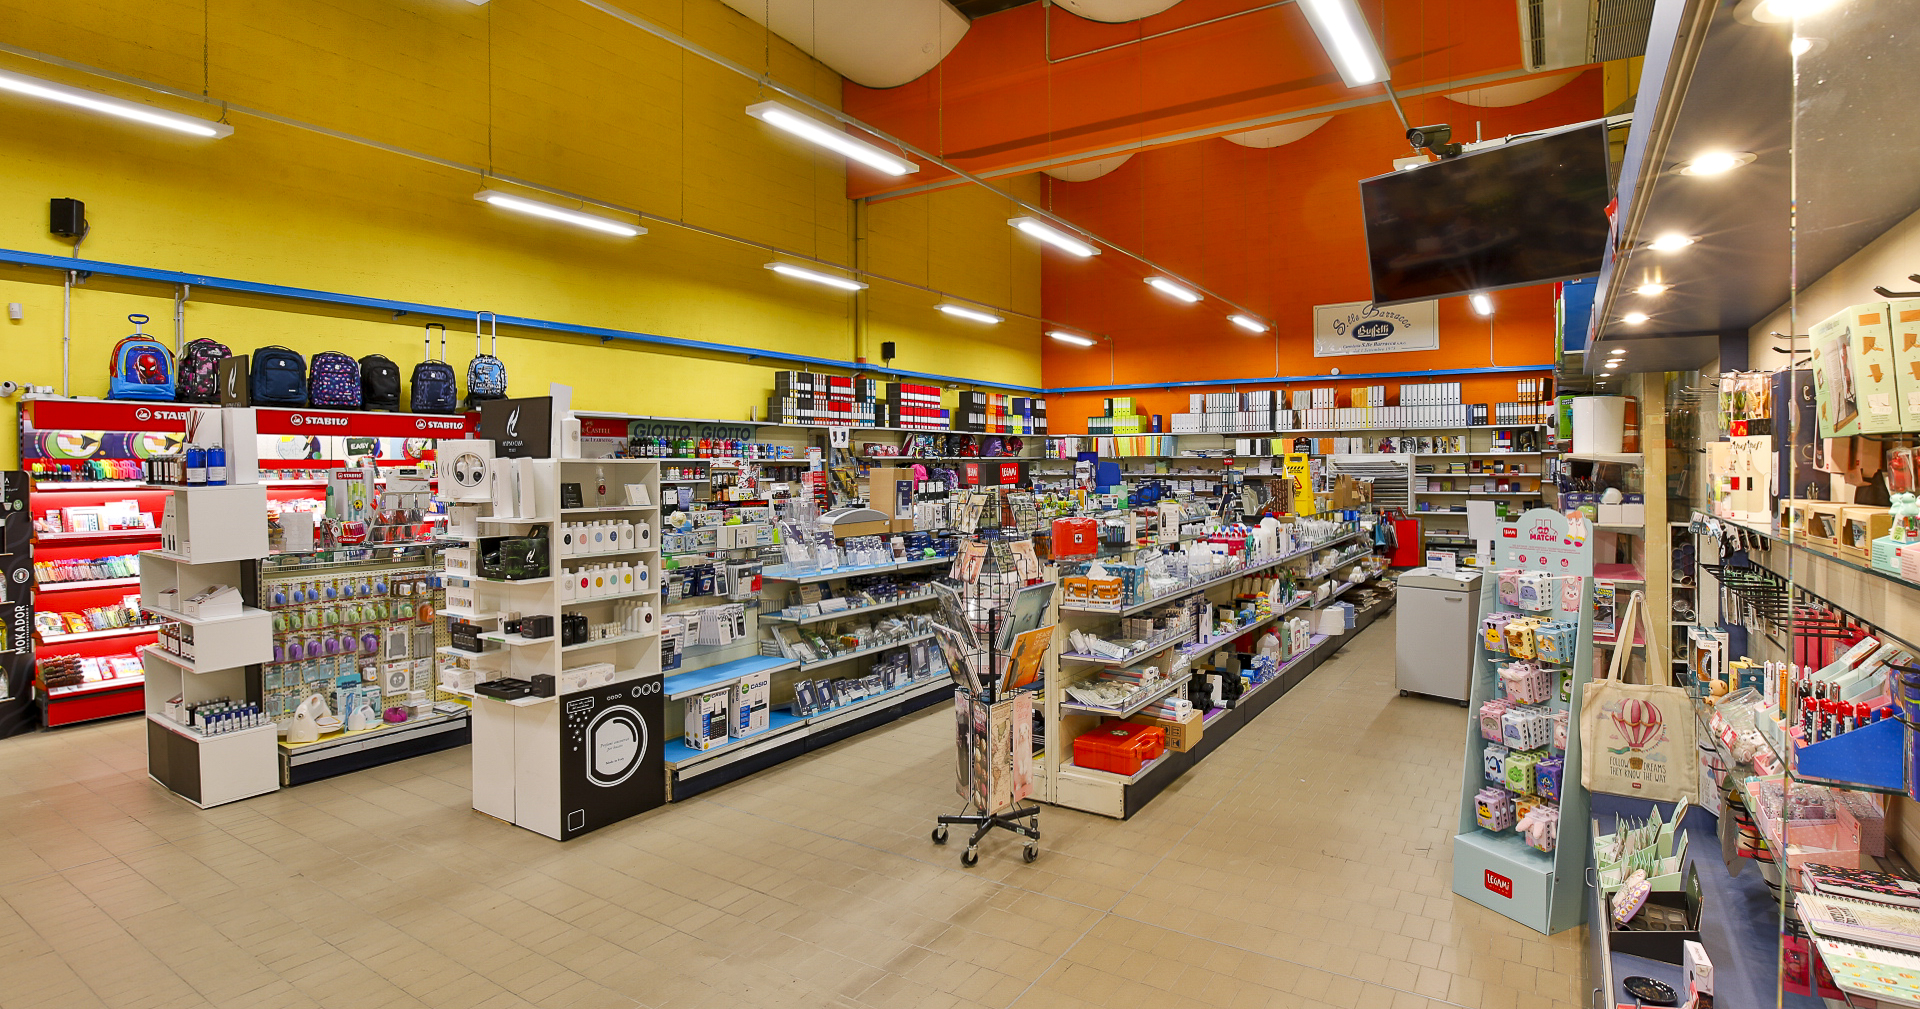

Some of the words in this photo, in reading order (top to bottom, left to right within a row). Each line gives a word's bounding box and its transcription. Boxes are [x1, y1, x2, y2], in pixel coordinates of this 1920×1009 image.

[154, 411, 186, 420] STAB
[305, 416, 348, 426] STABILO
[427, 421, 464, 430] STABILO
[634, 423, 691, 439] GIOTTO
[701, 426, 751, 441] GIOTTO
[1001, 467, 1017, 477] LEGAMI
[1530, 534, 1557, 542] MATCH!
[15, 605, 26, 655] MOKADOR
[750, 680, 768, 689] CASIO
[1610, 756, 1630, 768] FOLLOW
[1644, 762, 1667, 774] DREAMS
[1610, 766, 1622, 776] THEY
[1625, 769, 1641, 779] KNOW
[1643, 772, 1652, 781] THE
[1655, 774, 1666, 783] WAY
[1487, 873, 1510, 890] LEGAMI
